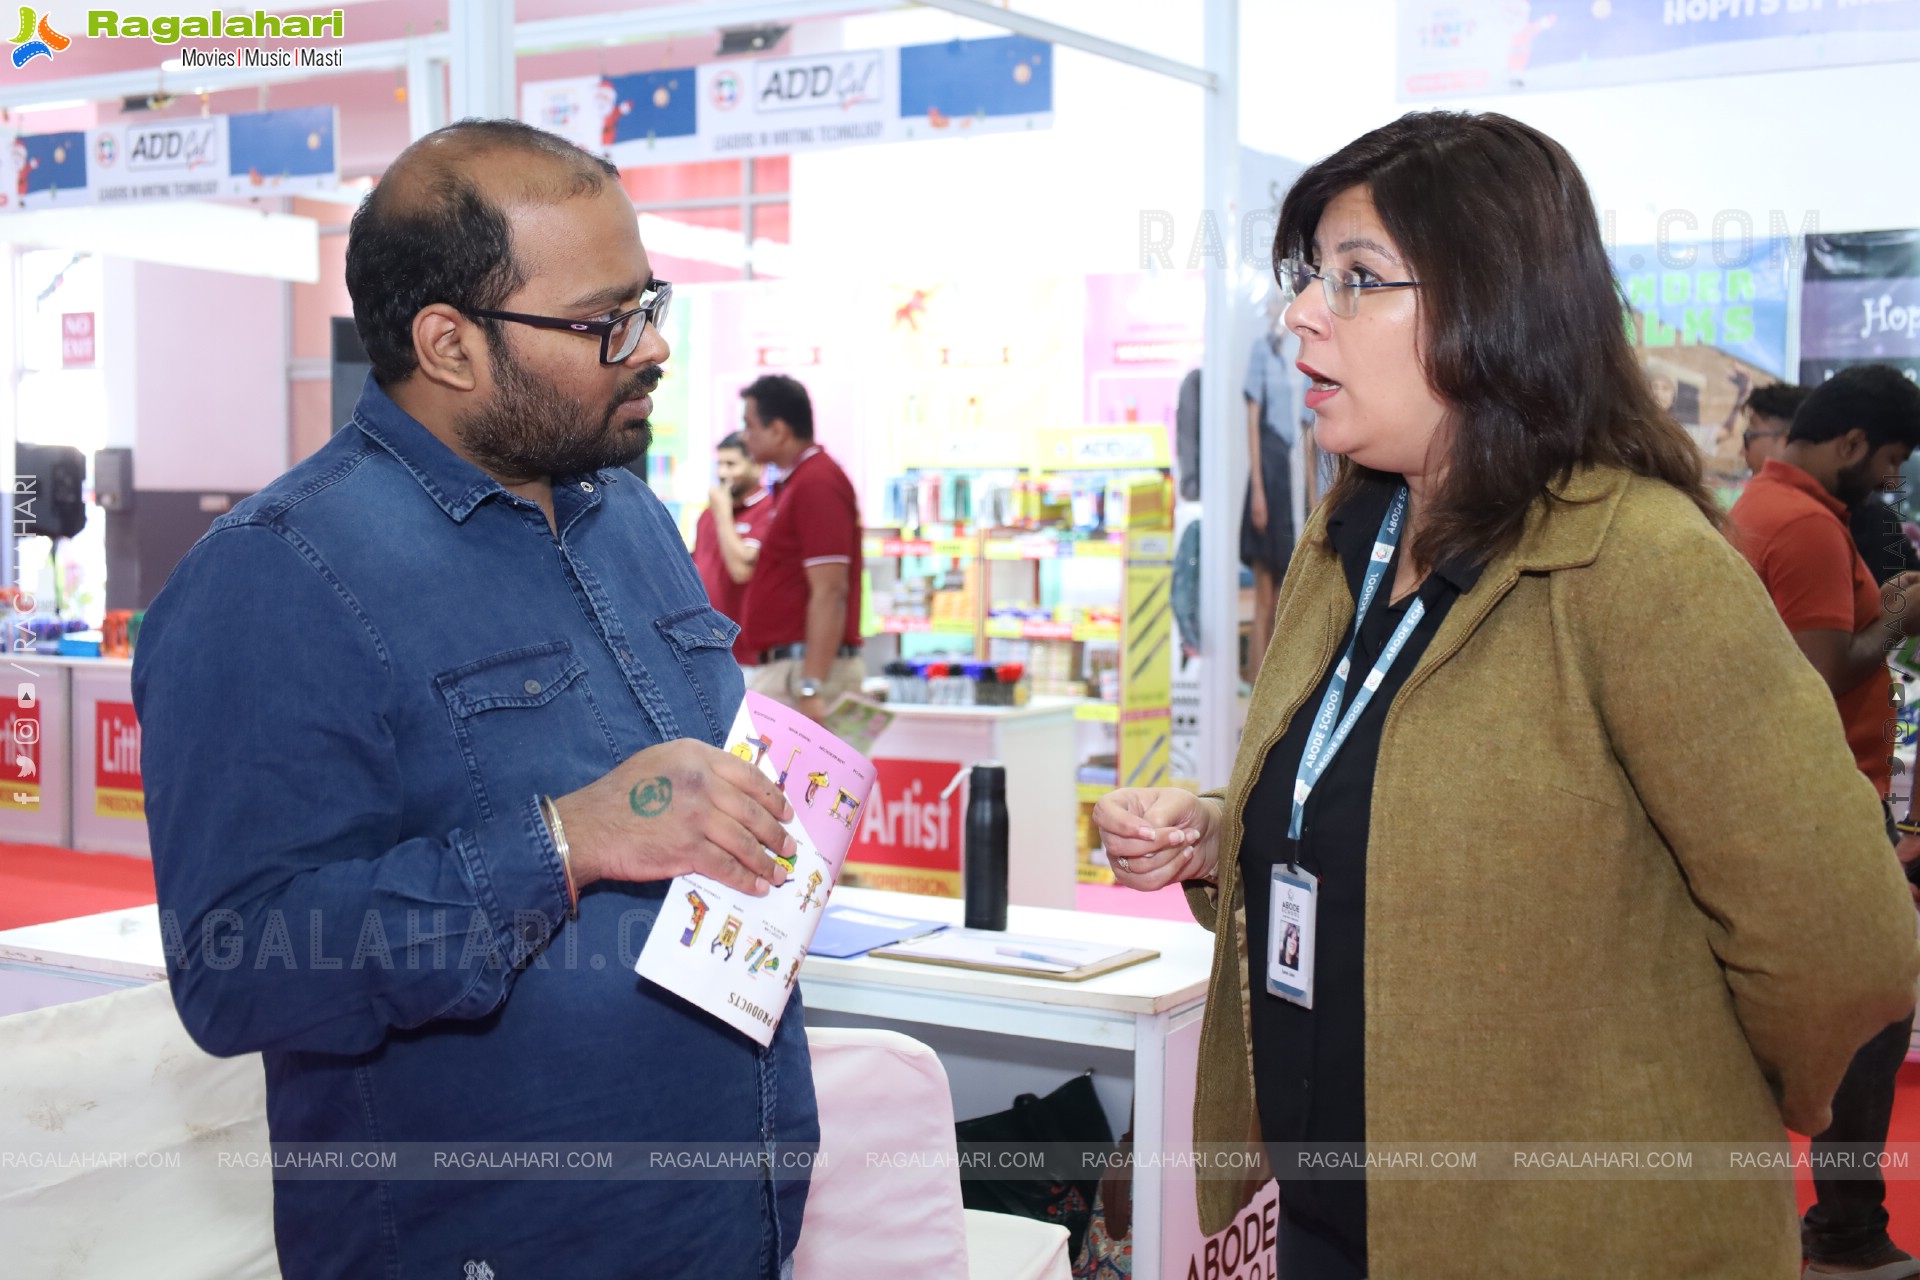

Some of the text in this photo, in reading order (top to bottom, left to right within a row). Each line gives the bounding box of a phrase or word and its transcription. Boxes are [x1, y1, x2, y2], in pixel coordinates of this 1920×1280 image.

[761, 65, 834, 101] ADD
[131, 130, 182, 161] ADD
[1386, 502, 1405, 535] ABODE
[1359, 572, 1379, 614] SCHOOL
[1385, 625, 1410, 661] ABODE
[1305, 689, 1341, 769] ABODE SCHOOL
[1313, 700, 1365, 776] ABODE SCHOOL
[859, 779, 950, 852] Artist
[727, 990, 774, 1028] PRODUCTS
[1187, 1198, 1277, 1280] ABODE
